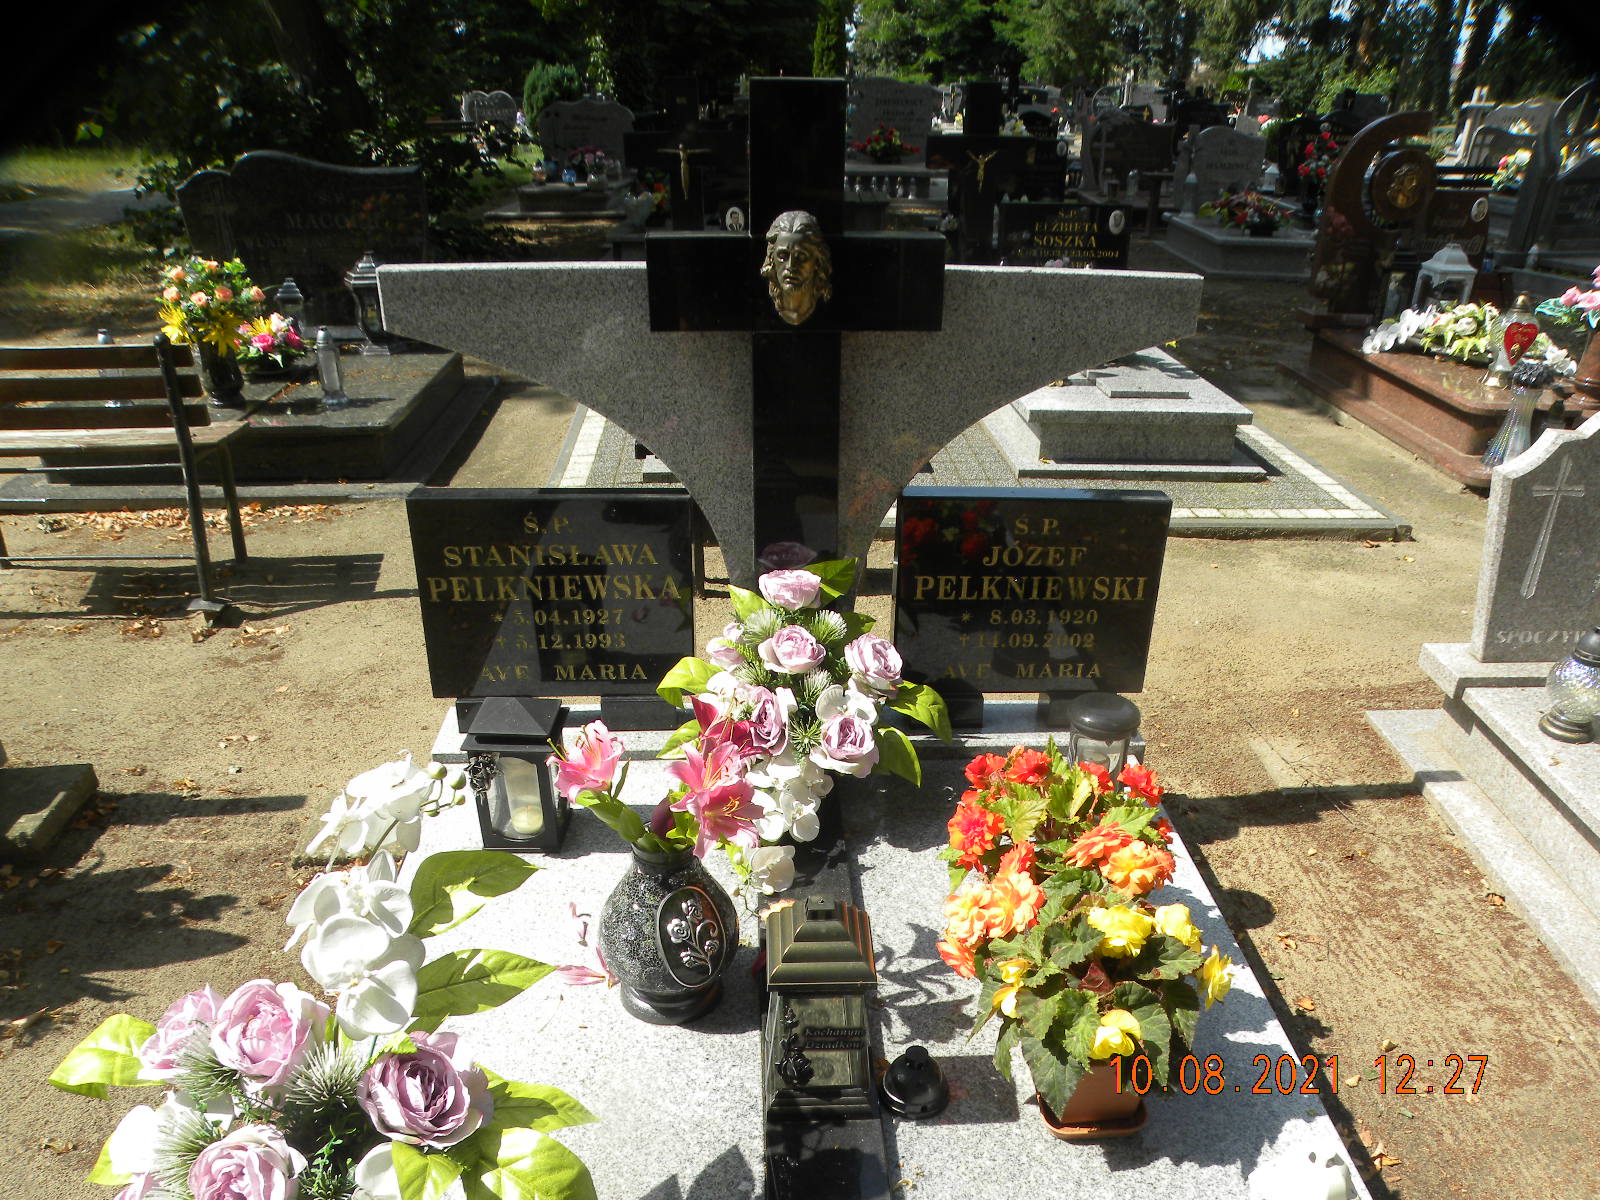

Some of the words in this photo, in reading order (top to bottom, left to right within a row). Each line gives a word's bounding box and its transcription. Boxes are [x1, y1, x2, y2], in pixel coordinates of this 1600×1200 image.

[1033, 235, 1097, 249] SOSZKA
[443, 543, 658, 568] STANISŁAWA
[982, 540, 1088, 567] JÓZEF
[426, 574, 682, 601] PELKNIEWSKA
[913, 575, 1148, 601] PELKNIEWSKI
[481, 664, 529, 682] AVE
[554, 663, 648, 681] MARIA
[944, 663, 992, 680] AVE
[1016, 663, 1102, 680] MARIA
